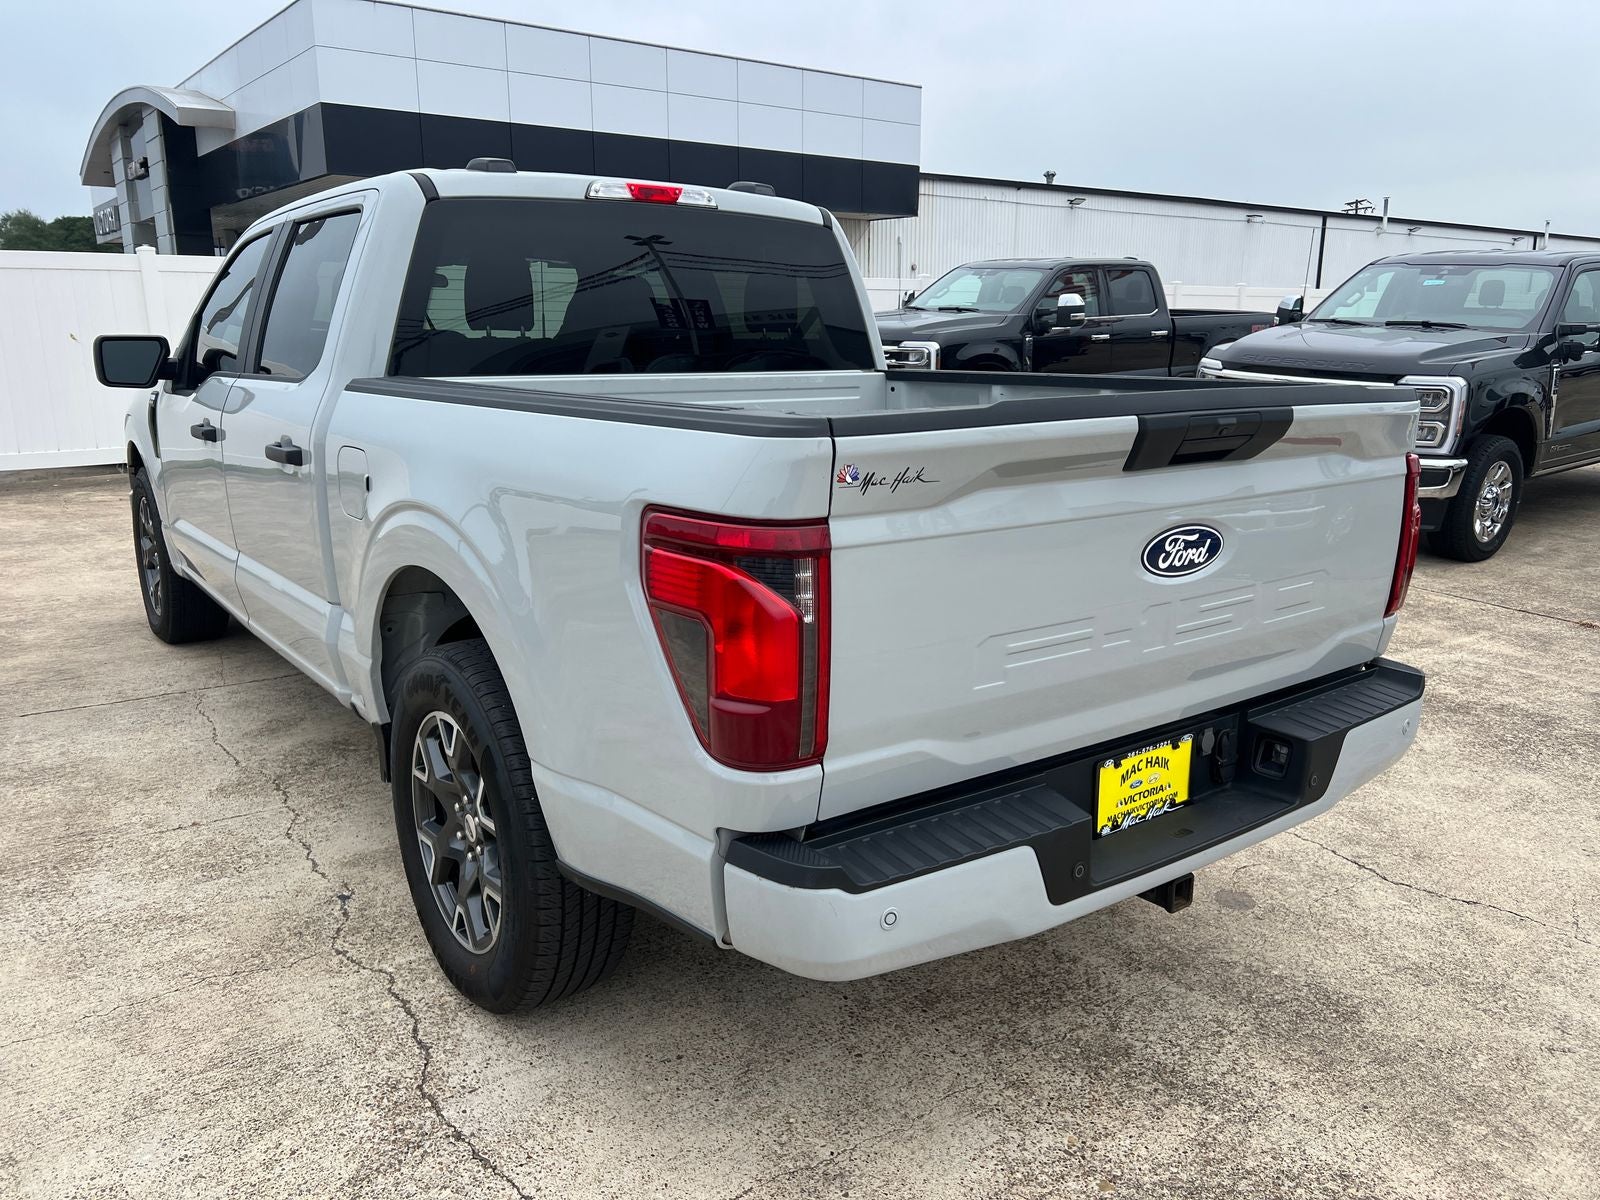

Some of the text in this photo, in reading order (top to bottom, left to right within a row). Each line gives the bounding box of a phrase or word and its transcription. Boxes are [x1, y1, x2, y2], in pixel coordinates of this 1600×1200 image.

[1240, 353, 1376, 371] SUPER DUTY
[859, 467, 941, 496] Mac Haik
[1158, 533, 1212, 569] Ford
[1120, 756, 1170, 787] MAC HAIK
[1123, 784, 1164, 806] VICTORIA
[1121, 799, 1184, 830] Mac Haik
